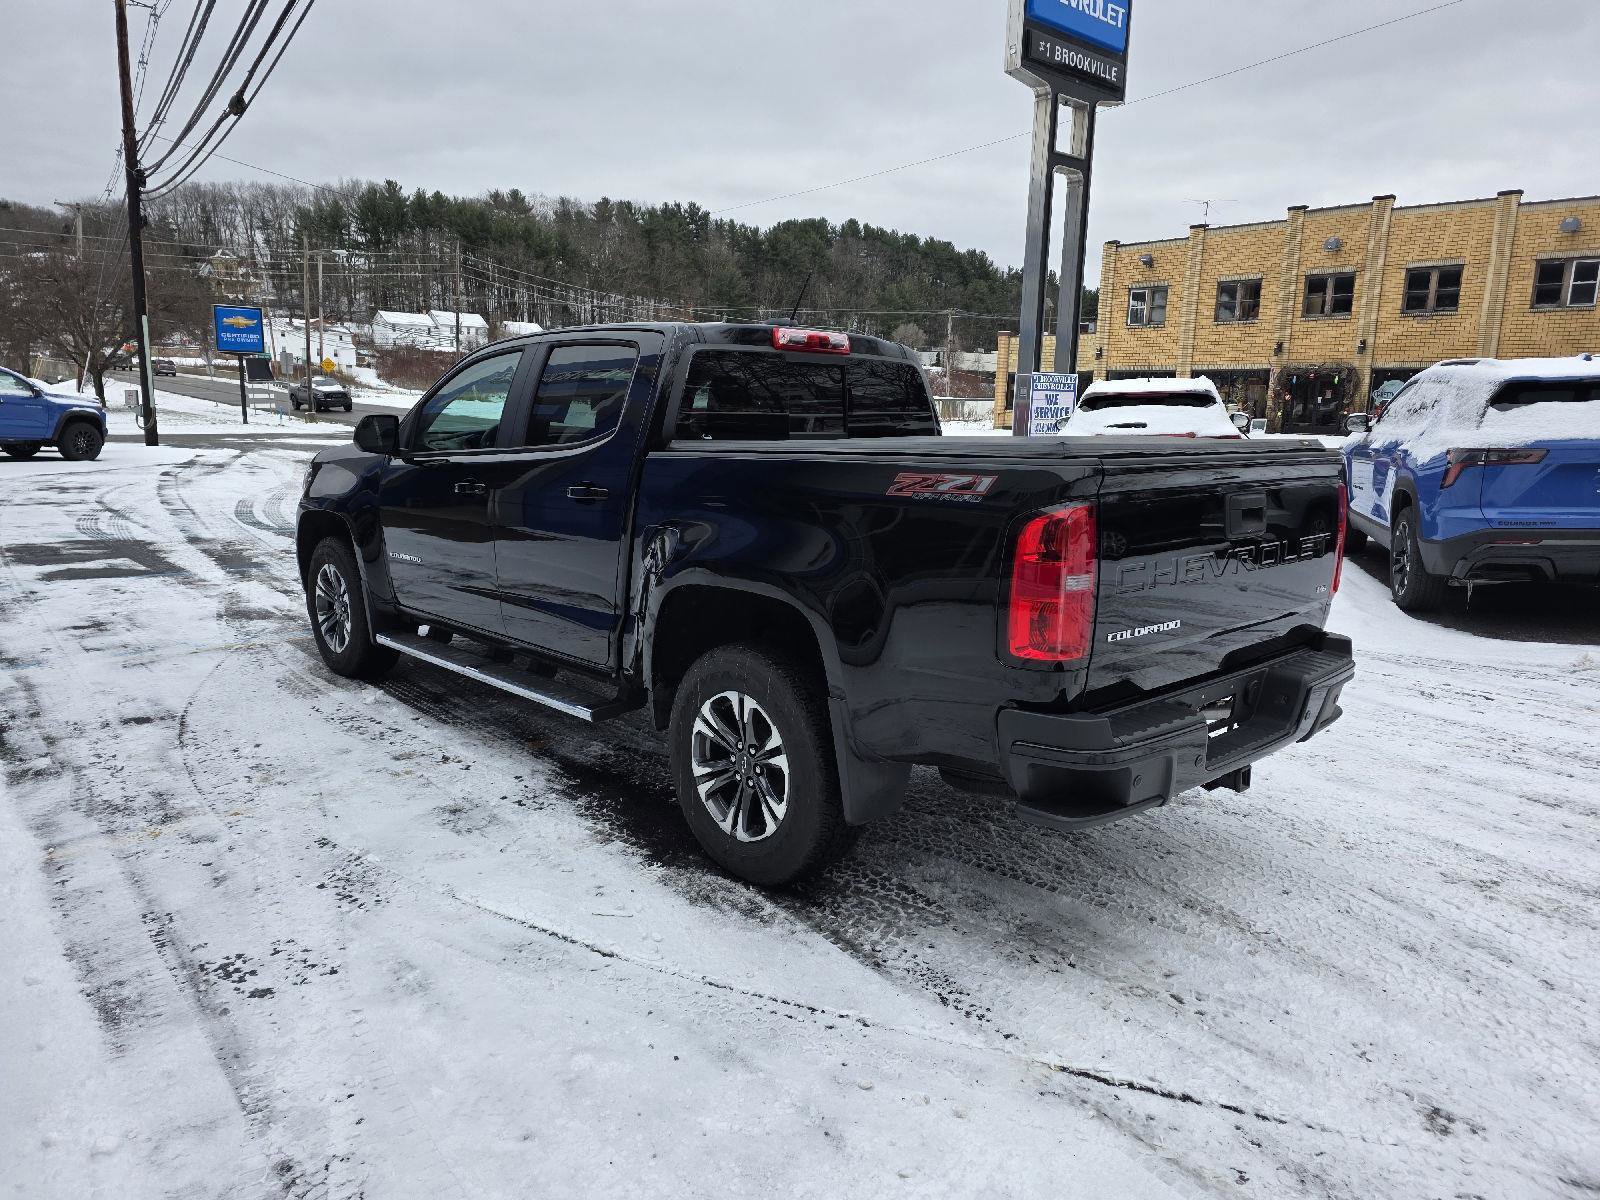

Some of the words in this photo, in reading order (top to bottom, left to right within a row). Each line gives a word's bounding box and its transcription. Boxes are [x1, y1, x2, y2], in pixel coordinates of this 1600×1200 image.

[1058, 0, 1126, 28] ROLET
[1055, 45, 1118, 81] BROOKVILLE
[1045, 394, 1060, 405] WE
[1034, 407, 1070, 418] SERVICE
[886, 472, 999, 497] Z71
[1115, 532, 1331, 595] CHEVROLET
[1107, 619, 1181, 642] COLORADO
